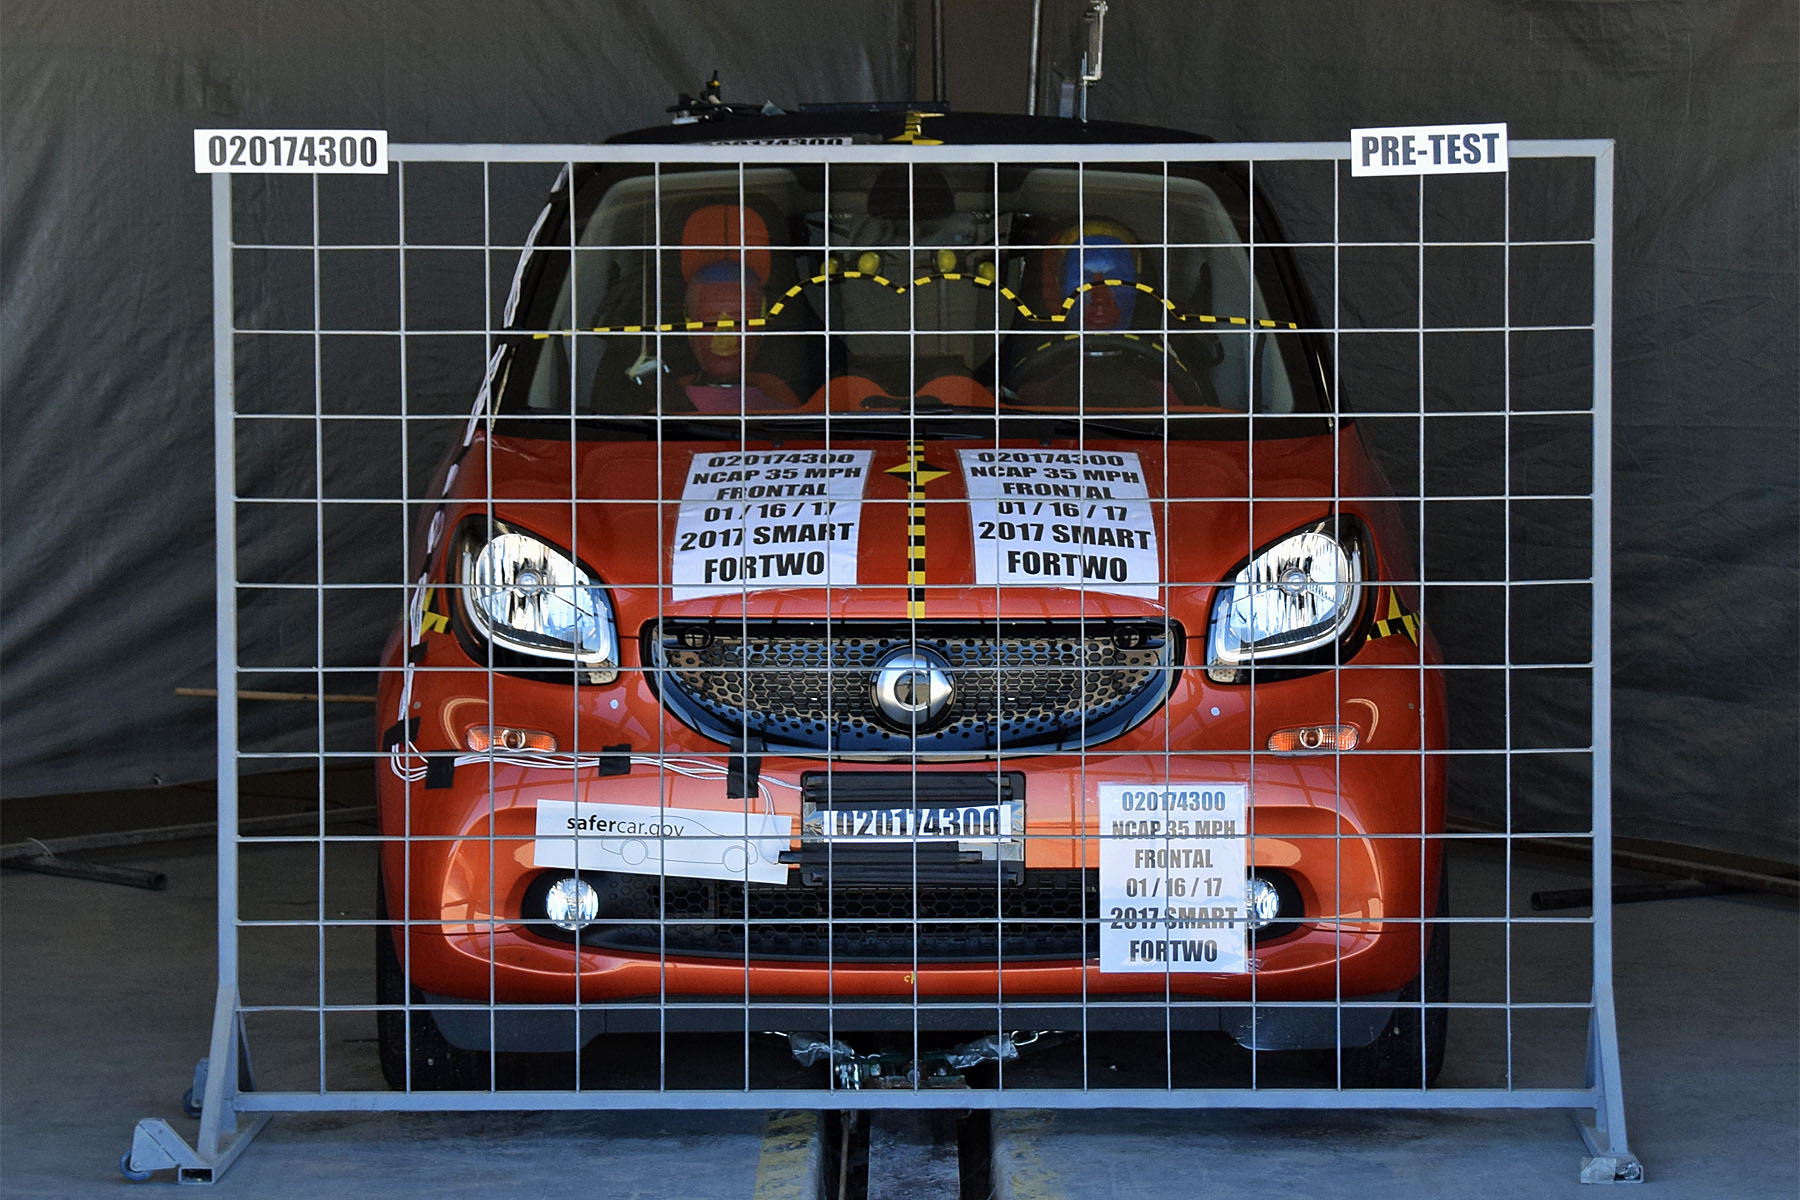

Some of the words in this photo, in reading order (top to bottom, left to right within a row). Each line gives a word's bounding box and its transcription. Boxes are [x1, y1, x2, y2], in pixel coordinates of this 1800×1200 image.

[208, 135, 378, 167] 020174300
[1361, 133, 1500, 167] PRE-TEST
[708, 454, 855, 468] 020174300
[978, 452, 1124, 466] 020174300
[692, 470, 760, 484] NCAP
[765, 468, 798, 480] 35
[804, 467, 861, 479] MPH
[970, 466, 1037, 478] NCAP
[1044, 468, 1077, 480] 35
[1084, 470, 1139, 484] MPH
[716, 483, 828, 500] FRONTAL
[1003, 482, 1115, 500] FRONTAL
[680, 528, 746, 552] 2017
[753, 523, 854, 545] SMART
[978, 522, 1044, 541] 2017
[1052, 524, 1151, 550] SMART
[704, 551, 825, 584] FORTWO
[1007, 551, 1128, 582] FORTWO
[1122, 791, 1226, 811] 020174300
[567, 814, 684, 838] safercar.gov
[836, 807, 999, 837] 020174300
[1112, 820, 1161, 840] NCAP
[1167, 820, 1190, 840] 35
[1195, 820, 1236, 840] MPH
[1134, 849, 1213, 869] FRONTAL
[1110, 907, 1159, 930] 2017
[1164, 907, 1238, 930] SMART
[1130, 940, 1218, 962] FORTWO
